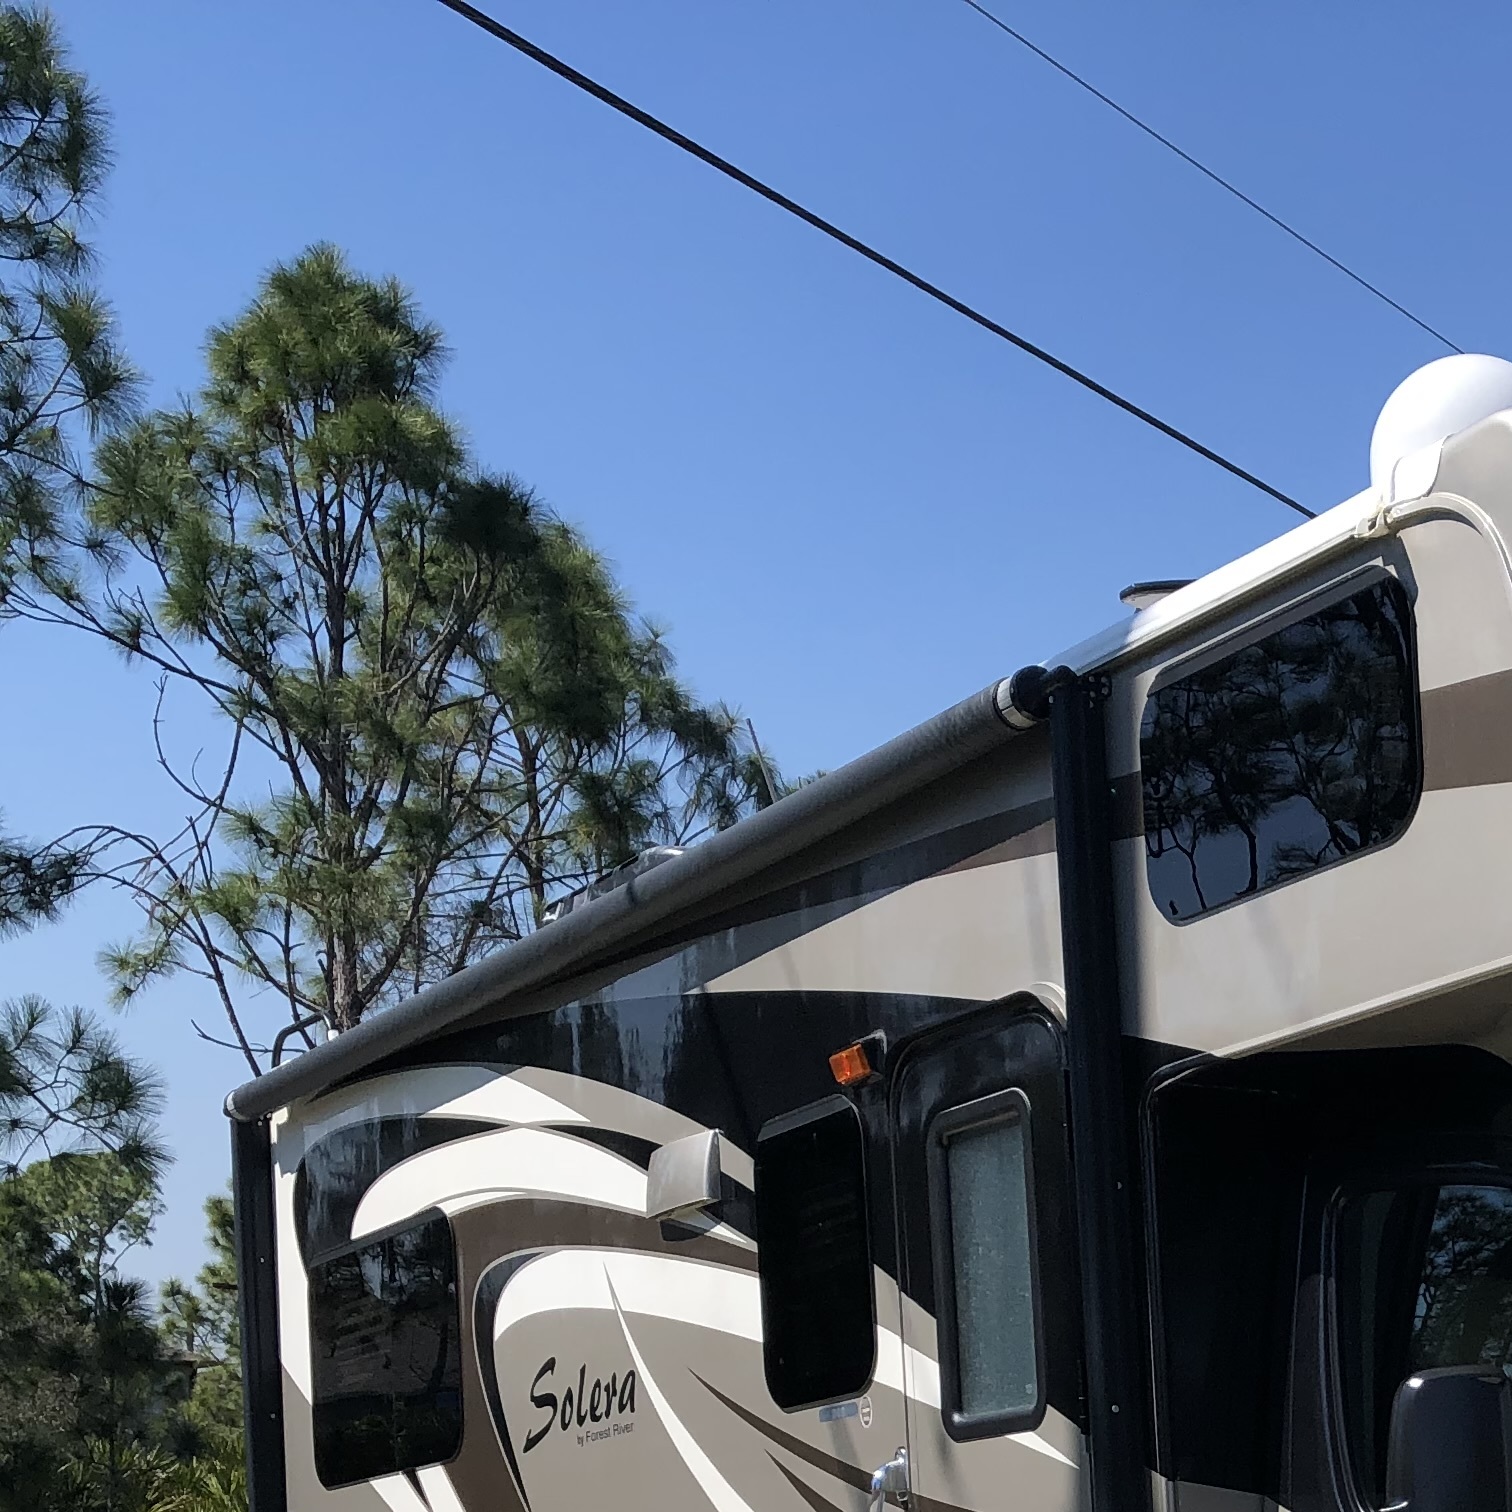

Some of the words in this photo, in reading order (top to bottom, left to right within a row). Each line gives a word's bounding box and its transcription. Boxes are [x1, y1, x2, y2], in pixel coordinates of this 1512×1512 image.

[522, 1356, 636, 1454] Solera
[576, 1435, 585, 1448] by
[585, 1426, 611, 1442] Forest
[612, 1422, 635, 1437] River
